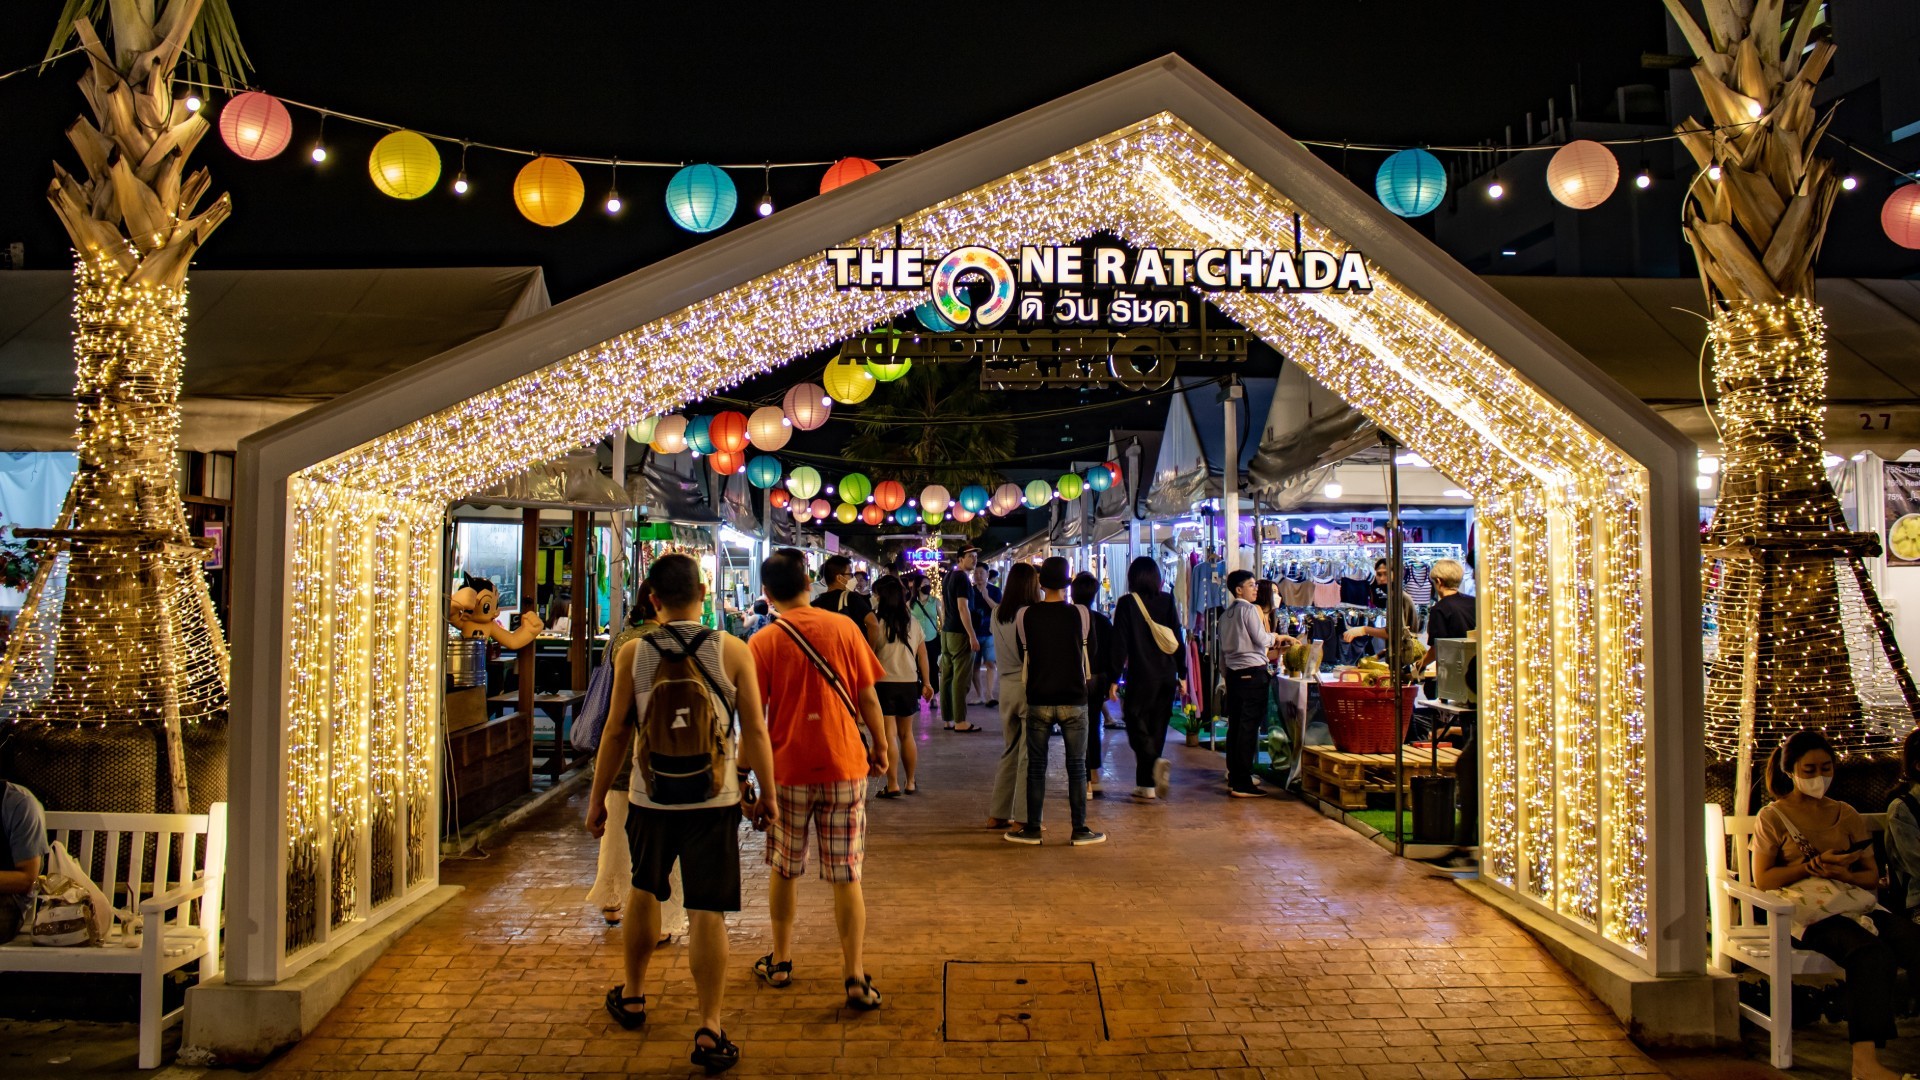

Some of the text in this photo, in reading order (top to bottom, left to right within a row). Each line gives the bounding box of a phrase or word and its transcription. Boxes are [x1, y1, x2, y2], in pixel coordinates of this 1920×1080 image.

[827, 248, 924, 287] THE
[1098, 247, 1373, 289] RATCHADA
[1020, 289, 1189, 324] ดิ วัน รัชดา
[1859, 412, 1892, 430] 27
[906, 551, 923, 560] THE
